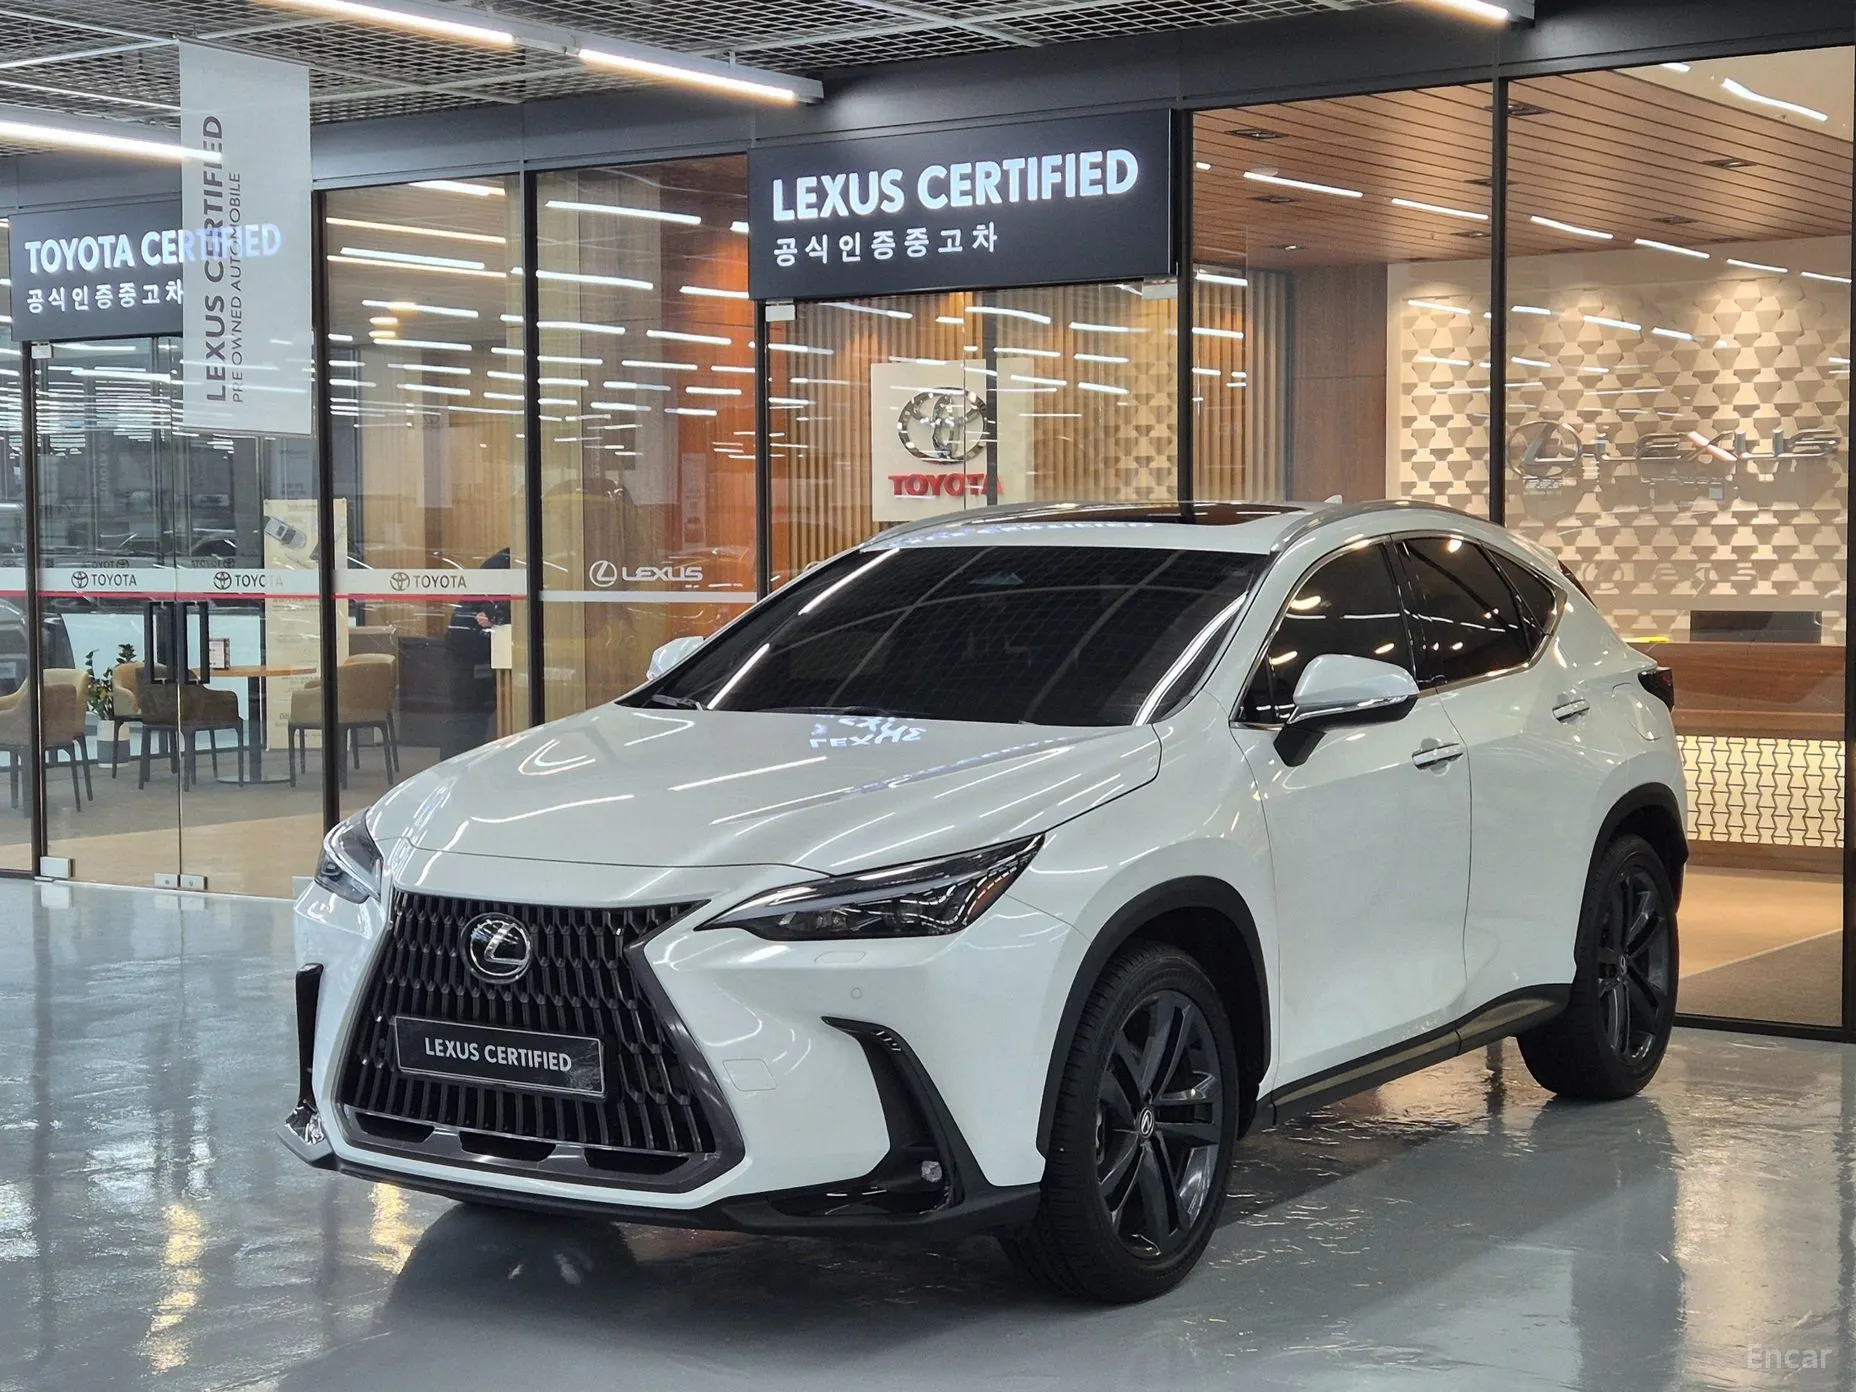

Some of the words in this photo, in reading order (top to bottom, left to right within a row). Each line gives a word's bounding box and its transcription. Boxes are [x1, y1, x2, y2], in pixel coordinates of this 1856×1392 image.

[772, 169, 905, 222] LEXUS
[917, 149, 1140, 210] CERTIFIED
[25, 234, 136, 274] TOYOTA
[773, 221, 998, 267] 공식인증중고차
[204, 295, 226, 402] LEXUS
[887, 472, 1005, 497] TOYOTA
[91, 573, 137, 587] TOYOTA
[413, 575, 467, 588] TOYOTA
[622, 566, 704, 582] LEXUS
[424, 1036, 480, 1062] LEXUS
[484, 1044, 573, 1073] CERTIFIED
